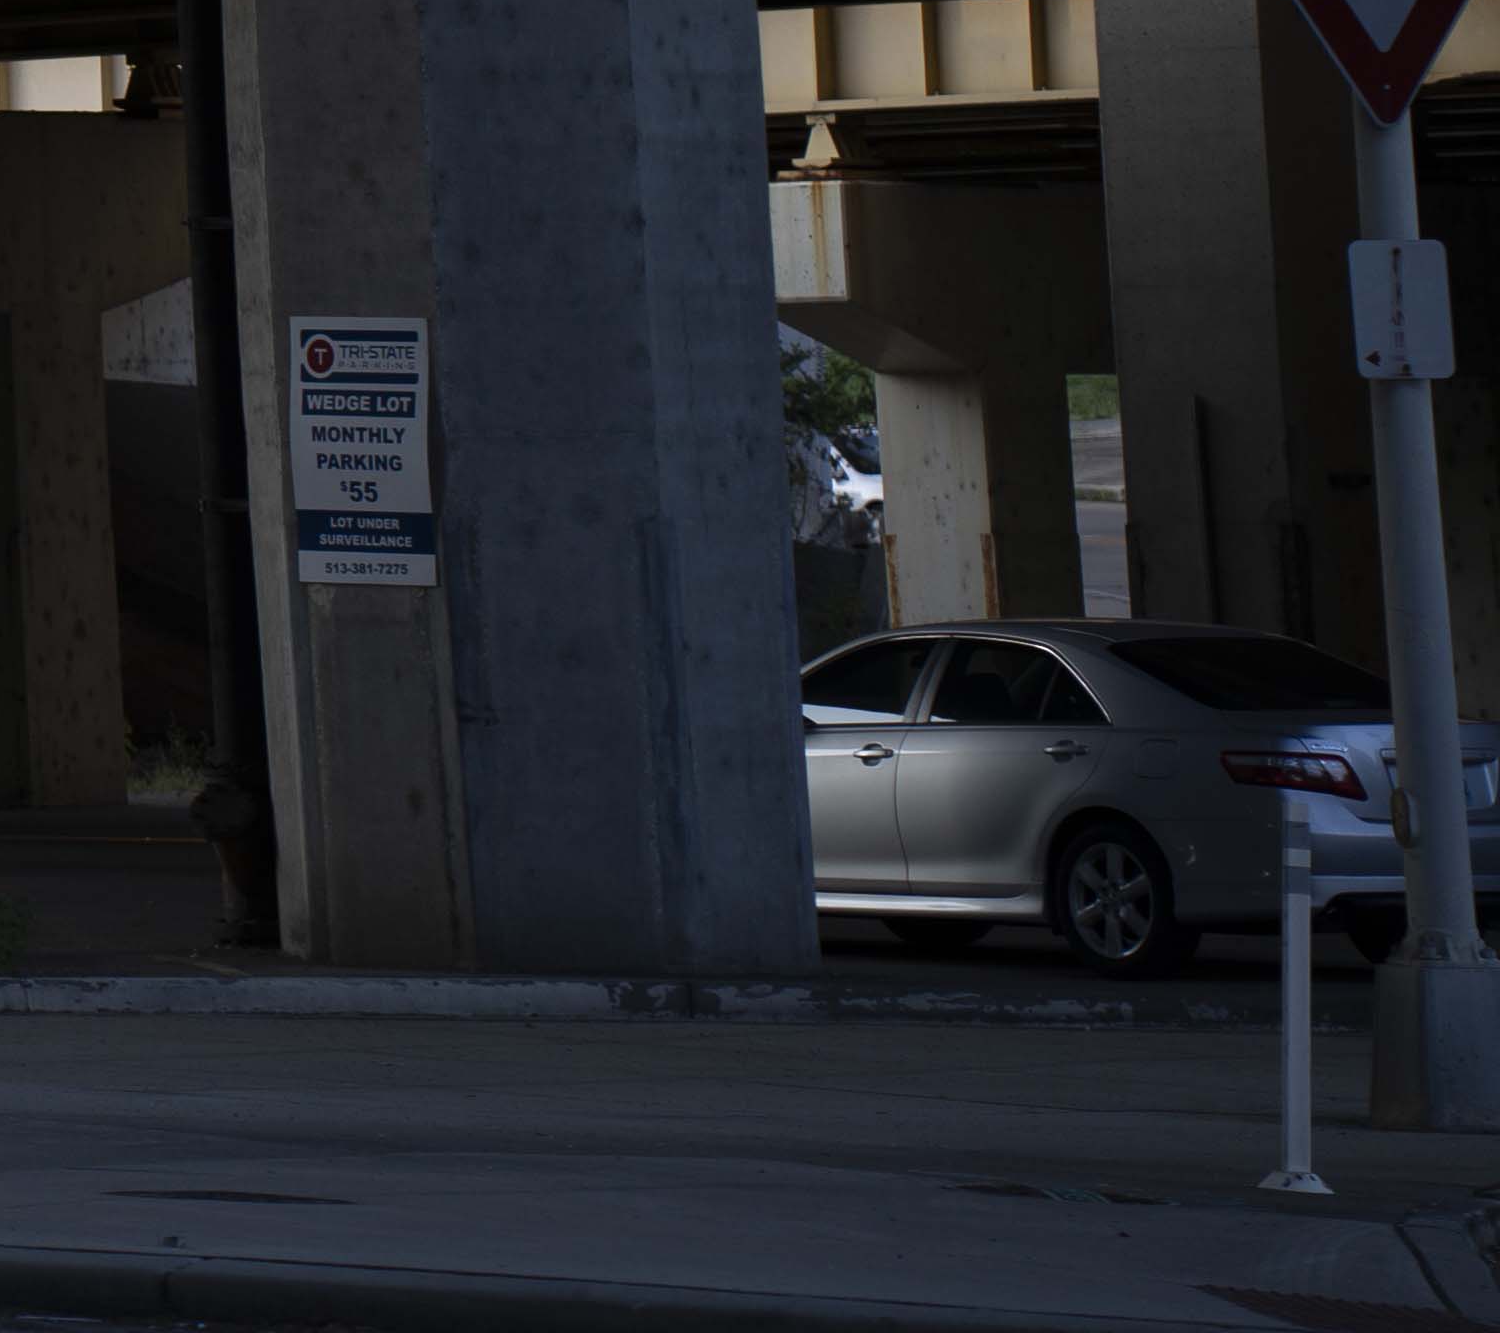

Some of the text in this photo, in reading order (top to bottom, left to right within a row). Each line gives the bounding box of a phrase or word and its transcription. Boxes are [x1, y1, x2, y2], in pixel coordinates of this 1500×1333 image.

[339, 344, 416, 360] TRI-STATE
[307, 394, 412, 413] WEDGE LOT
[311, 425, 405, 444] MONTHLY
[316, 453, 403, 472] PARKING
[340, 480, 378, 503] $55
[330, 516, 400, 531] LOT UNDER
[319, 534, 413, 549] SURVEILLANCE
[324, 562, 408, 575] 513-381-7275
